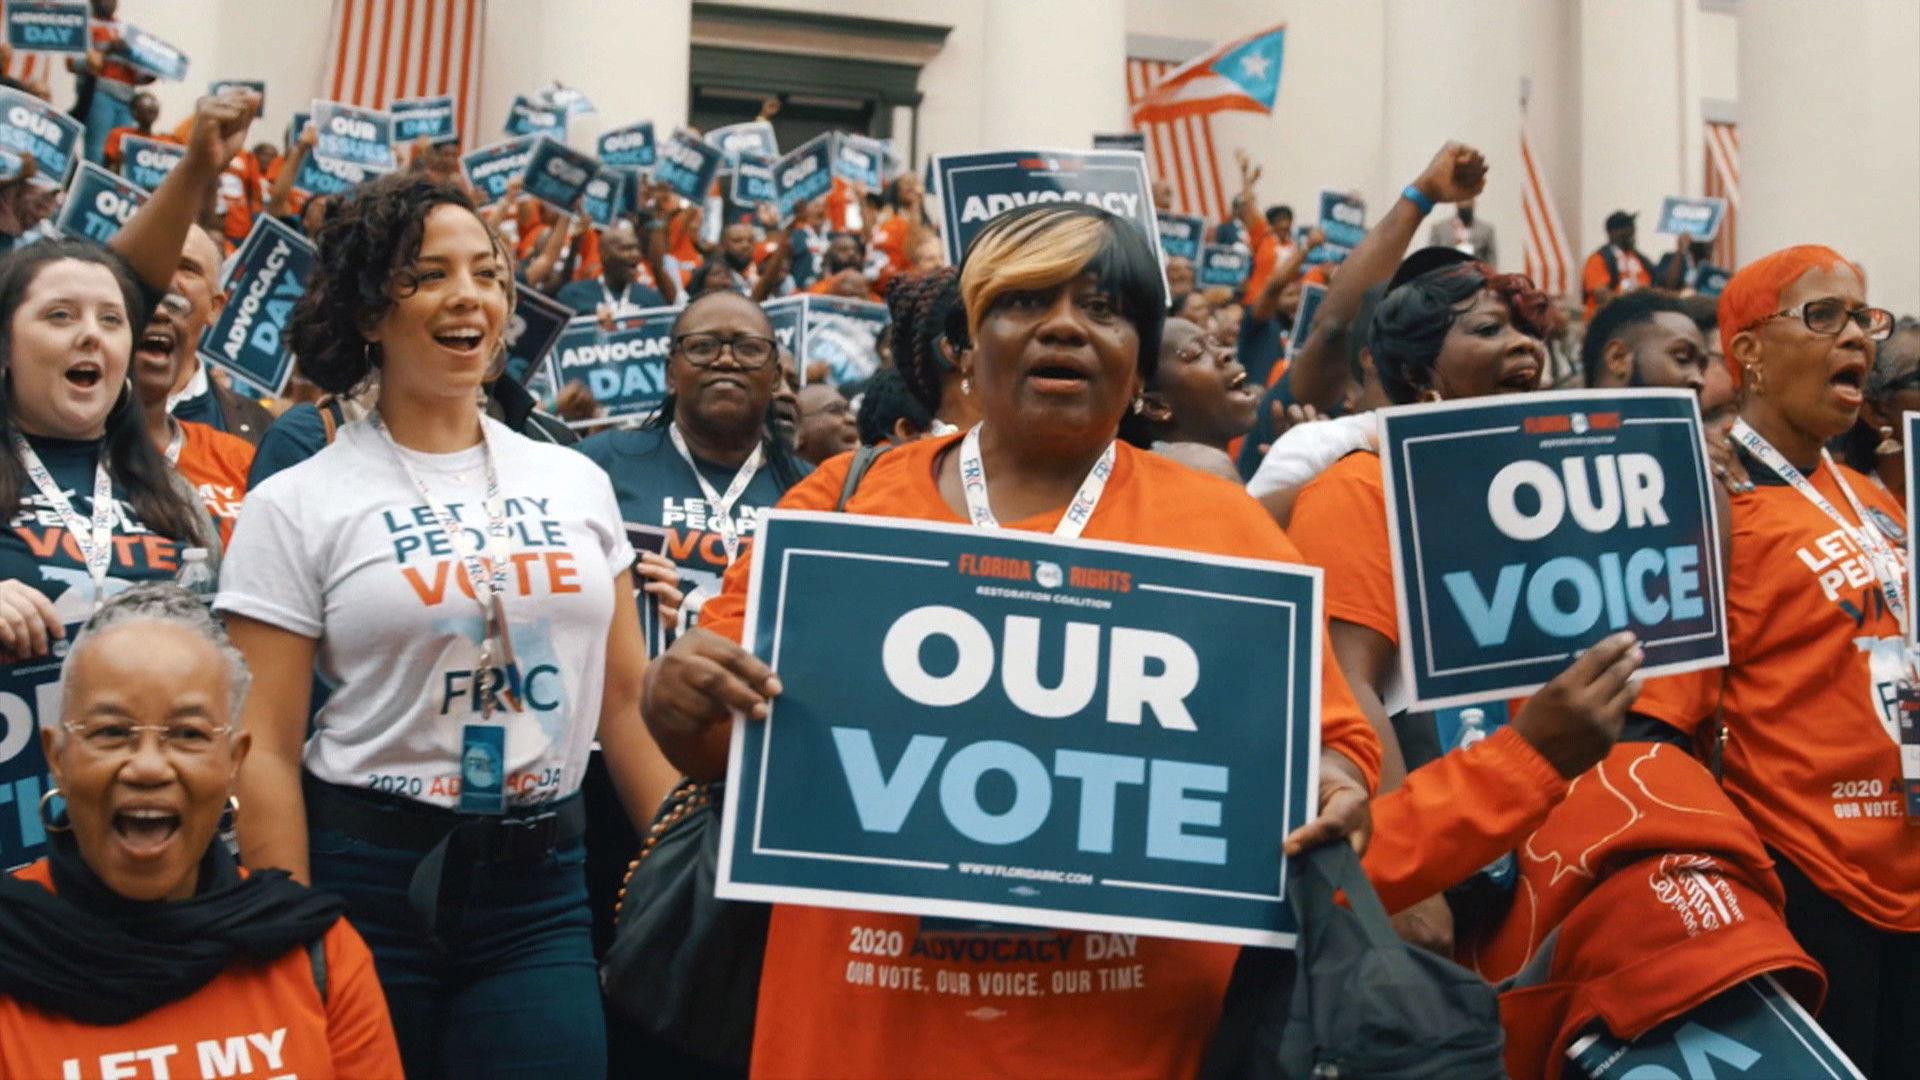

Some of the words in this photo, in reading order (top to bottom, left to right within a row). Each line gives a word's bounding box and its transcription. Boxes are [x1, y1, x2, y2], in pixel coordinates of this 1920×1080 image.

[23, 25, 73, 43] DAY
[8, 107, 63, 146] OUR
[331, 116, 377, 141] OUR
[402, 119, 441, 136] DAY
[603, 131, 644, 154] OUR
[782, 155, 818, 189] OUR
[96, 190, 137, 224] OU
[224, 239, 292, 361] ADVOCACY
[251, 269, 305, 356] DAY
[561, 336, 671, 369] ADVOCAC
[663, 496, 713, 514] LE
[1487, 453, 1670, 541] OUR
[662, 511, 757, 536] PEOP
[401, 552, 581, 608] VOTE
[957, 553, 1032, 581] FLORIDA
[1068, 565, 1132, 593] RIGHTS
[975, 585, 1051, 603] RESTORATION
[1052, 593, 1113, 610] COALITION
[1442, 545, 1705, 649] VOICE
[882, 605, 1199, 732] OUR
[368, 774, 423, 797] 2020
[831, 726, 1229, 866] VOTE
[1831, 778, 1884, 799] 2020
[1833, 803, 1861, 819] OUR
[849, 926, 904, 957] 2020
[910, 934, 1075, 964] ADVOCACY
[1085, 933, 1138, 961] DAY
[846, 960, 874, 985] OUR
[936, 969, 971, 996] OUR
[1051, 969, 1091, 994] OUR
[1097, 964, 1146, 992] TIME
[61, 1044, 178, 1080] LET
[196, 1028, 287, 1079] MY
